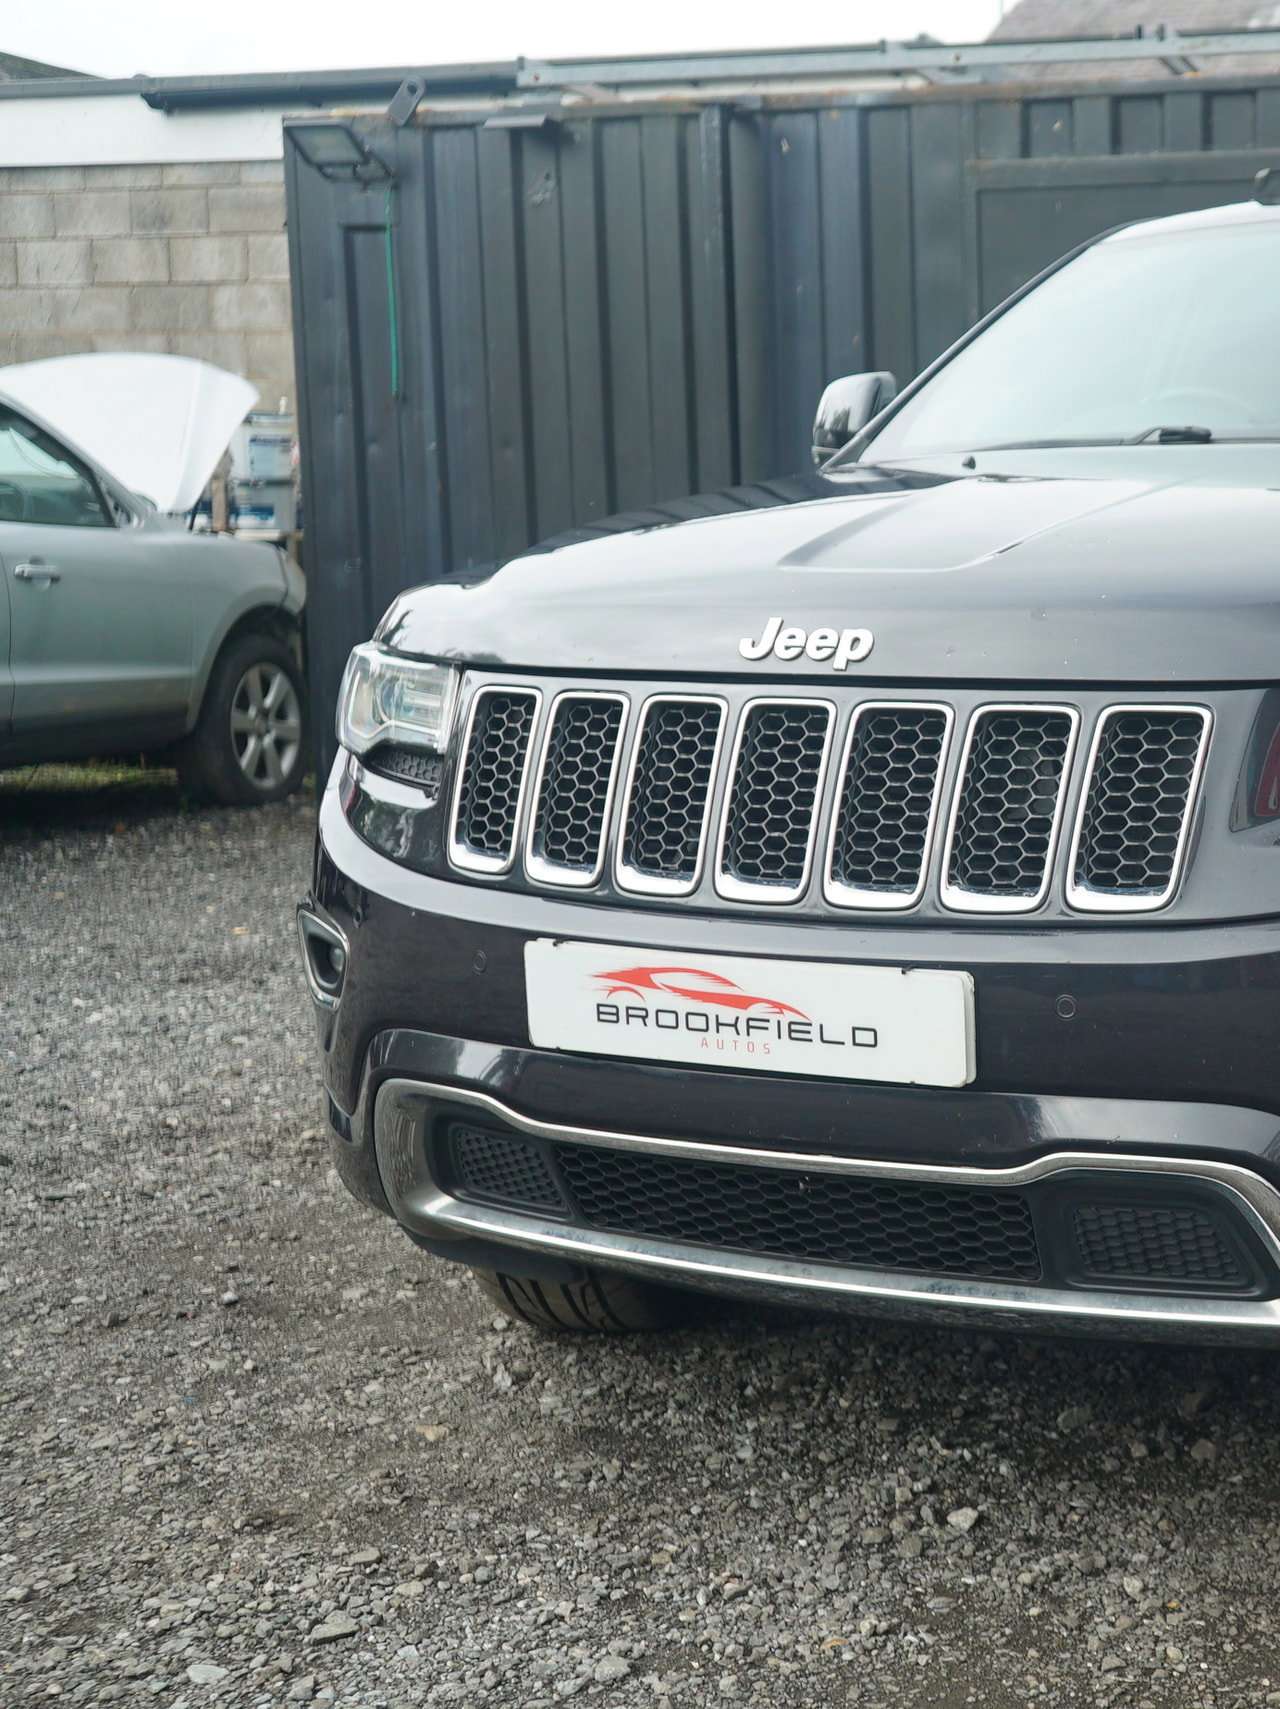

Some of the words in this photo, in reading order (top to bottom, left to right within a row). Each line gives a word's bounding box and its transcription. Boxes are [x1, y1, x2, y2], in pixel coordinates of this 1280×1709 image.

[739, 616, 875, 671] Jeep
[596, 1003, 879, 1048] BROOKFIELD
[700, 1037, 772, 1055] AUTOS
